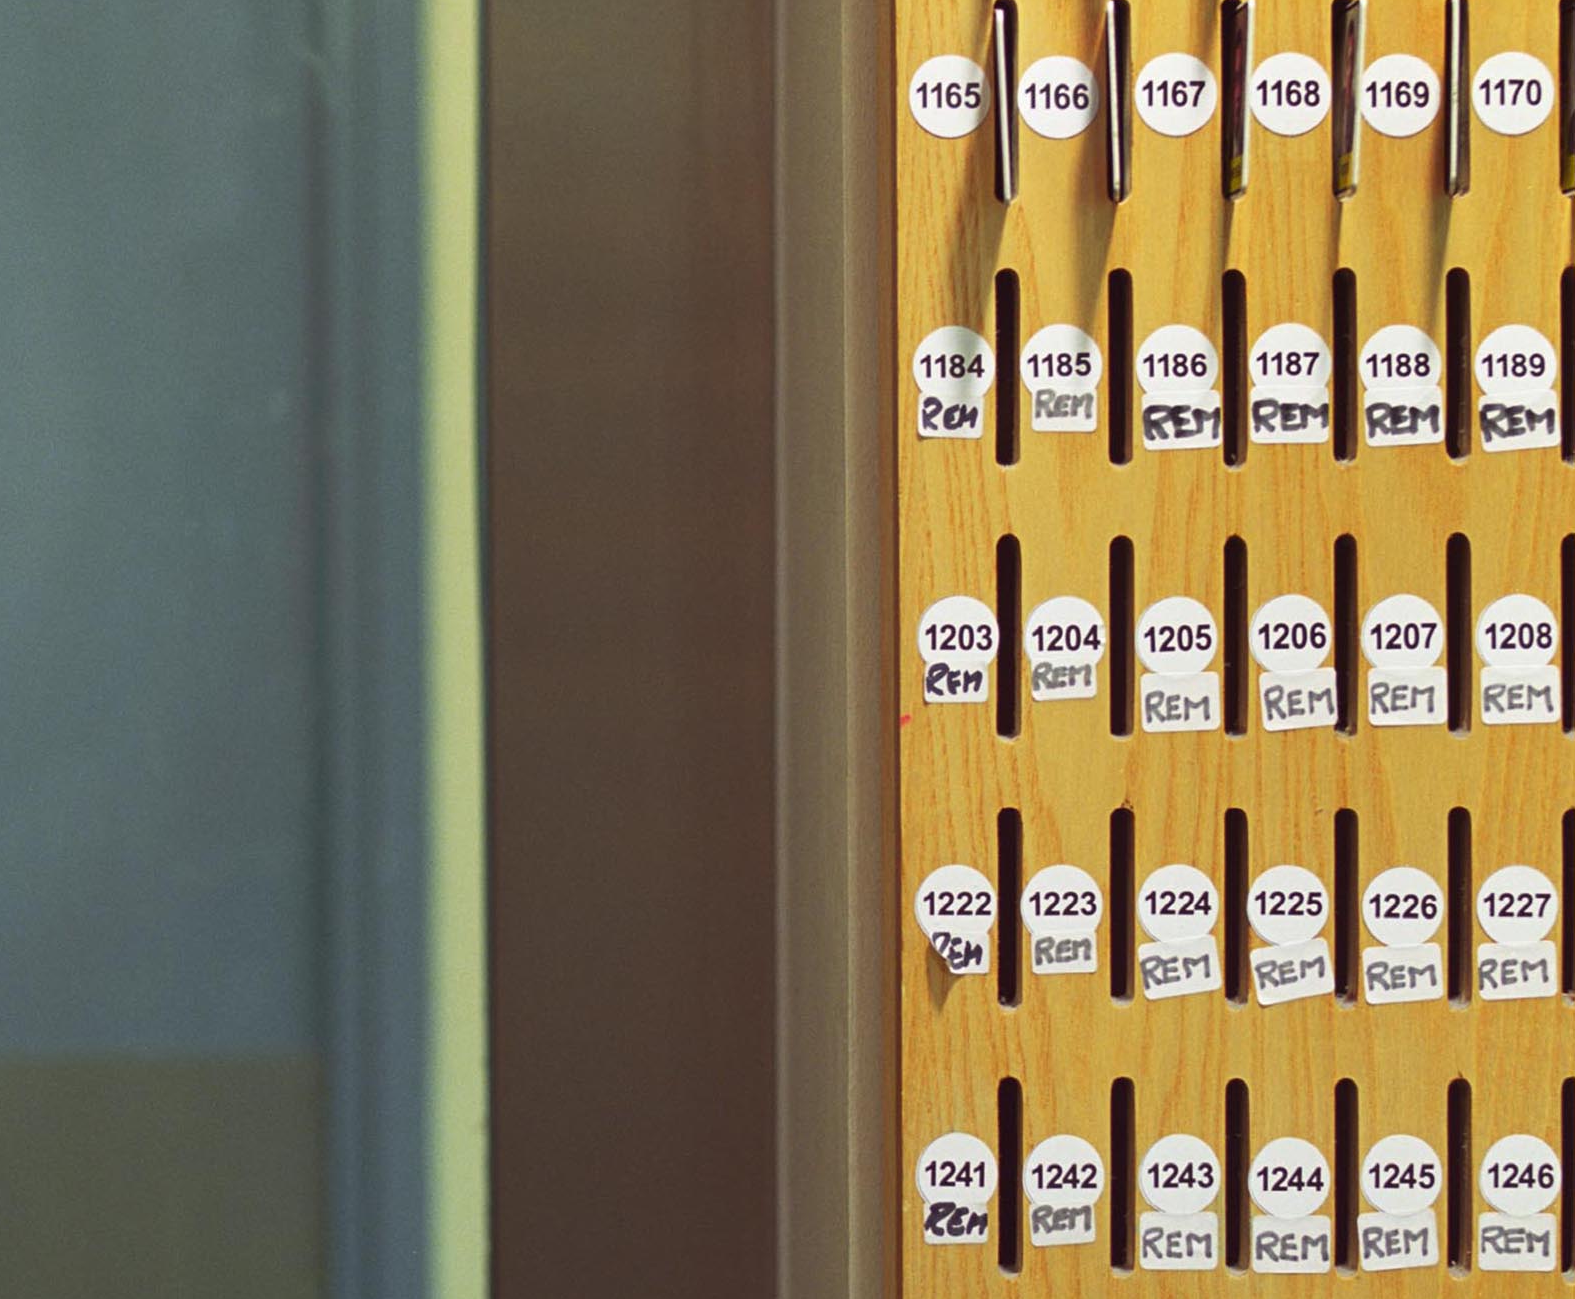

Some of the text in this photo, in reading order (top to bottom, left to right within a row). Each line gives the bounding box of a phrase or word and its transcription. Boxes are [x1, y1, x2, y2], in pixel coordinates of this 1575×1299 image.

[916, 82, 980, 109] 1165
[1025, 83, 1090, 111] 1166
[1142, 80, 1206, 108] 1167
[1256, 79, 1320, 107] 1168
[1365, 81, 1430, 108] 1169
[1479, 78, 1542, 106] 1170
[920, 353, 985, 379] 1184
[1027, 351, 1092, 378] 1185
[1143, 353, 1208, 378] 1186
[1256, 351, 1320, 376] 1187
[1366, 352, 1431, 378] 1188
[1481, 353, 1546, 378] 1189
[922, 397, 980, 431] REM
[1033, 388, 1095, 419] REM
[1252, 400, 1329, 434] REM
[1142, 402, 1222, 442] REM
[1364, 402, 1441, 437] REM
[1480, 404, 1557, 444] REM
[925, 623, 993, 651] 1203
[1032, 624, 1101, 652] 1204
[1144, 624, 1212, 653] 1205
[1258, 622, 1327, 650] 1206
[1370, 622, 1438, 650] 1207
[1485, 622, 1553, 650] 1208
[925, 663, 984, 697] REM
[1030, 661, 1093, 691] REM
[1144, 689, 1212, 725] REM
[1263, 686, 1336, 721] REM
[1369, 681, 1436, 716] REM
[1482, 682, 1554, 714] REM
[923, 891, 992, 916] 1222
[1029, 891, 1097, 916] 1223
[1145, 890, 1212, 916] 1224
[1254, 890, 1323, 917] 1225
[1369, 893, 1438, 920] 1226
[1483, 892, 1552, 918] 1227
[1034, 936, 1093, 967] REM
[1140, 955, 1213, 991] REM
[1254, 955, 1328, 991] REM
[1364, 959, 1437, 992] REM
[1477, 957, 1550, 991] REM
[925, 1160, 985, 1188] 1241
[1031, 1163, 1098, 1190] 1242
[1147, 1162, 1214, 1189] 1243
[1256, 1166, 1325, 1192] 1244
[1368, 1162, 1435, 1190] 1245
[1487, 1162, 1555, 1189] 1246
[924, 1200, 989, 1238] REM
[1030, 1203, 1093, 1233] REM
[1141, 1228, 1213, 1262] REM
[1254, 1230, 1330, 1264] REM
[1361, 1227, 1431, 1261] REM
[1481, 1226, 1552, 1257] REM
